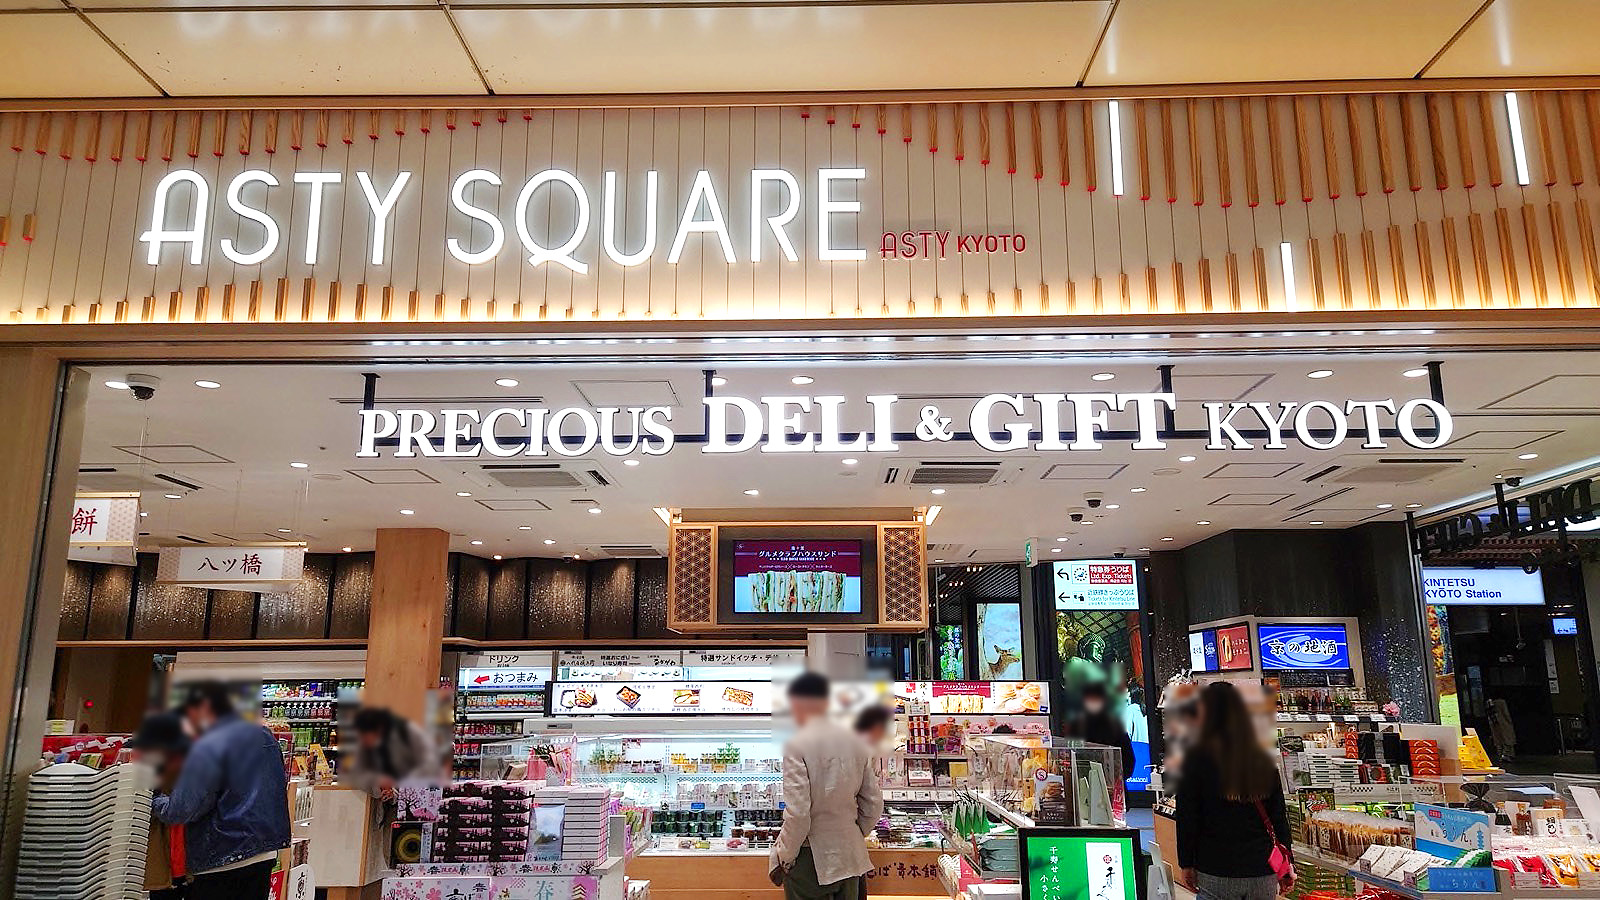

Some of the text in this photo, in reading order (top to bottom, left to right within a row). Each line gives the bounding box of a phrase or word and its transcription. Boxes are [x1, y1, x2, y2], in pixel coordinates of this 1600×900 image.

[140, 167, 867, 275] ASTY SQUARE
[880, 231, 1026, 259] ASTY KYOTO
[356, 391, 1454, 457] PRECIOUS DELI & GIFT KYOTO
[197, 553, 263, 576] 八ツ橋
[1423, 578, 1476, 587] KINTETSU
[1466, 589, 1502, 598] Station
[1268, 638, 1338, 656] 京の地酒
[489, 655, 520, 663] ドリンク
[493, 672, 539, 684] おつまみ
